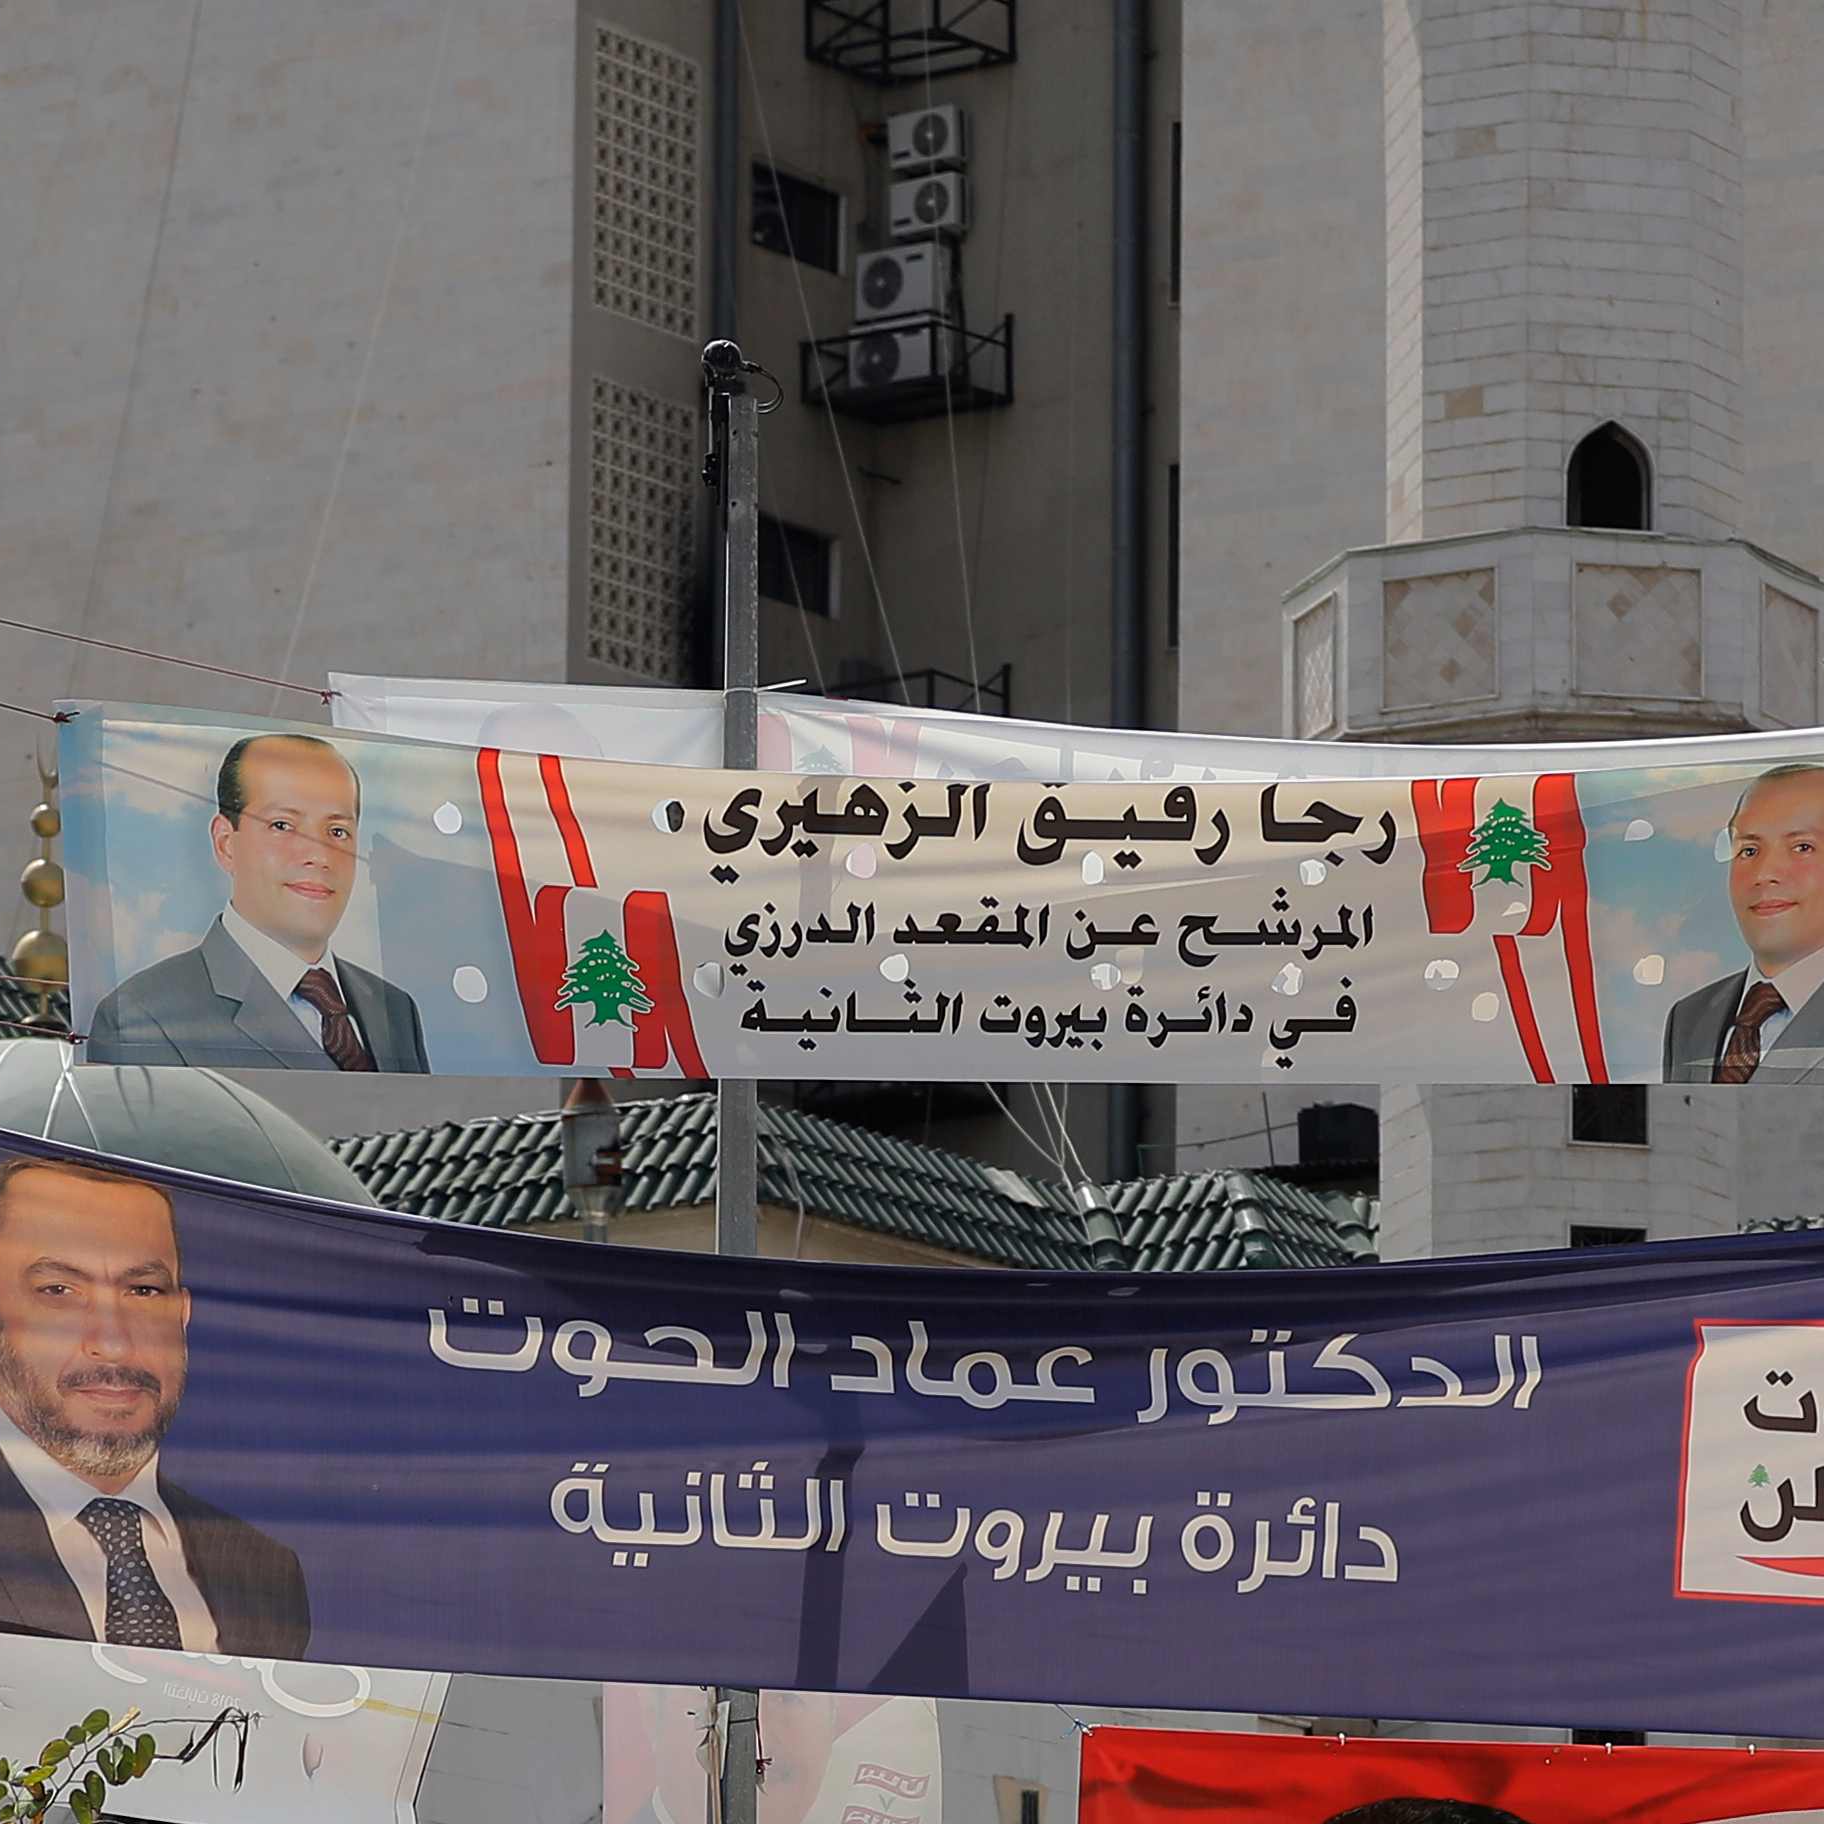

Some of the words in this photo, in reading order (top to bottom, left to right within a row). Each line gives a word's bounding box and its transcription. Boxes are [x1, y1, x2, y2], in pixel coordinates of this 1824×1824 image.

[702, 780, 990, 884] الزهيري
[1017, 780, 1231, 869] رفيق
[1260, 782, 1397, 865] رجا
[723, 901, 877, 976] الدرزي
[892, 901, 1050, 950] المقعد
[1064, 905, 1160, 962] عن
[1178, 887, 1374, 966] المرشح
[738, 981, 964, 1049] الثانية
[978, 991, 1109, 1050] بيروت
[1127, 990, 1253, 1049] دائرة
[1267, 975, 1357, 1069] في
[427, 1291, 793, 1397] الحوت
[832, 1320, 1097, 1404] عماد
[1137, 1329, 1540, 1425] الدكتور
[551, 1460, 849, 1568] الثانية
[872, 1492, 1153, 1594] بيروت
[1181, 1488, 1399, 1594] دائرة
